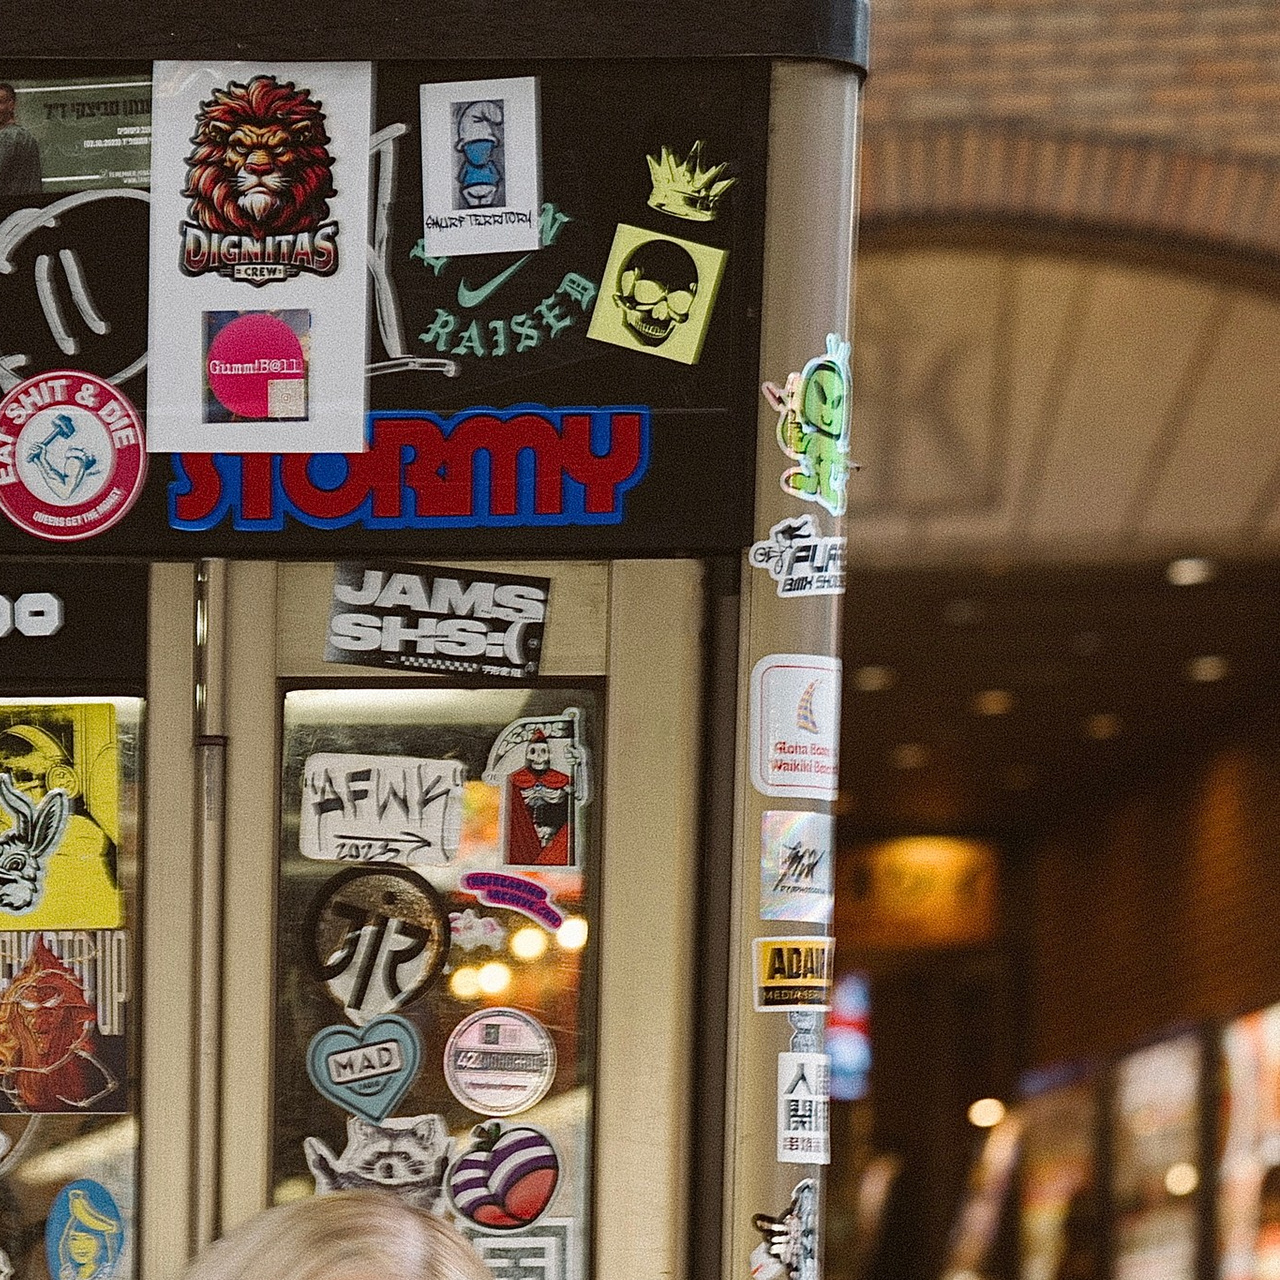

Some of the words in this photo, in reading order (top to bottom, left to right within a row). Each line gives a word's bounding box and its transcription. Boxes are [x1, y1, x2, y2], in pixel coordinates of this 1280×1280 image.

[183, 222, 338, 272] DIGNITAS
[243, 265, 278, 279] CREW
[419, 273, 598, 357] RAISED
[5, 377, 69, 427] SHIT
[75, 382, 97, 408] &
[101, 397, 139, 452] DIE
[173, 408, 646, 526] STORMY
[333, 569, 546, 622] JAMS
[331, 1046, 395, 1079] MAD
